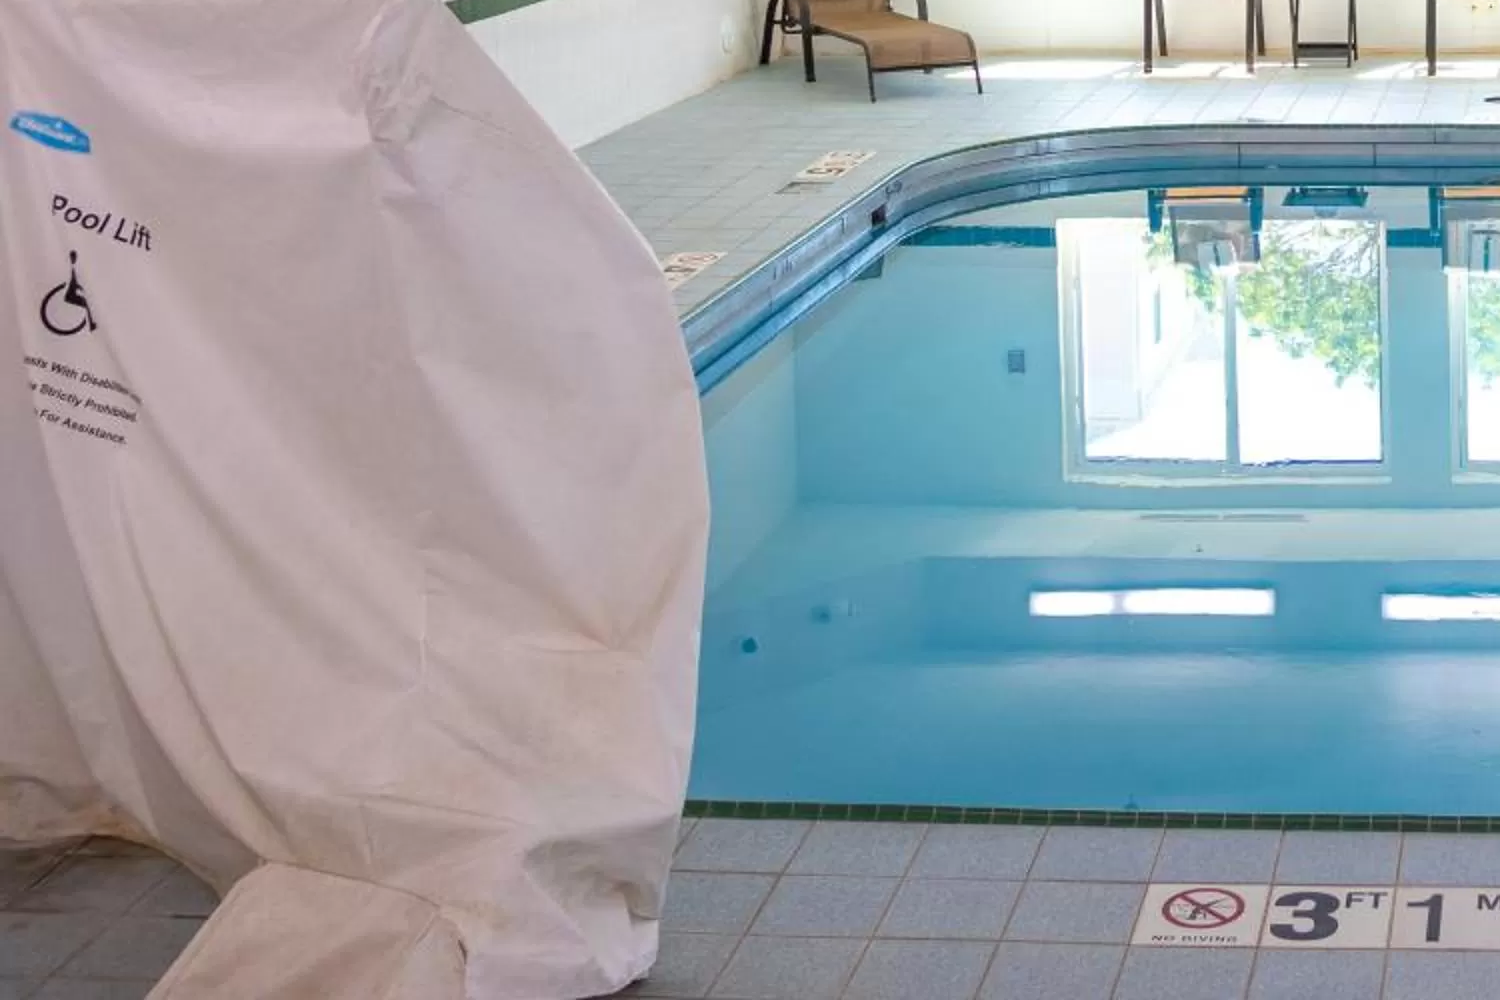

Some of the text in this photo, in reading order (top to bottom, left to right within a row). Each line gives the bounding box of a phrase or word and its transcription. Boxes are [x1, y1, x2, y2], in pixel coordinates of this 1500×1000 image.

[52, 194, 151, 251] Pool Lift
[51, 361, 78, 380] With
[1269, 891, 1341, 941] 3
[1345, 892, 1389, 909] FT
[1406, 894, 1444, 942] 1
[1181, 935, 1238, 943] DIVING
